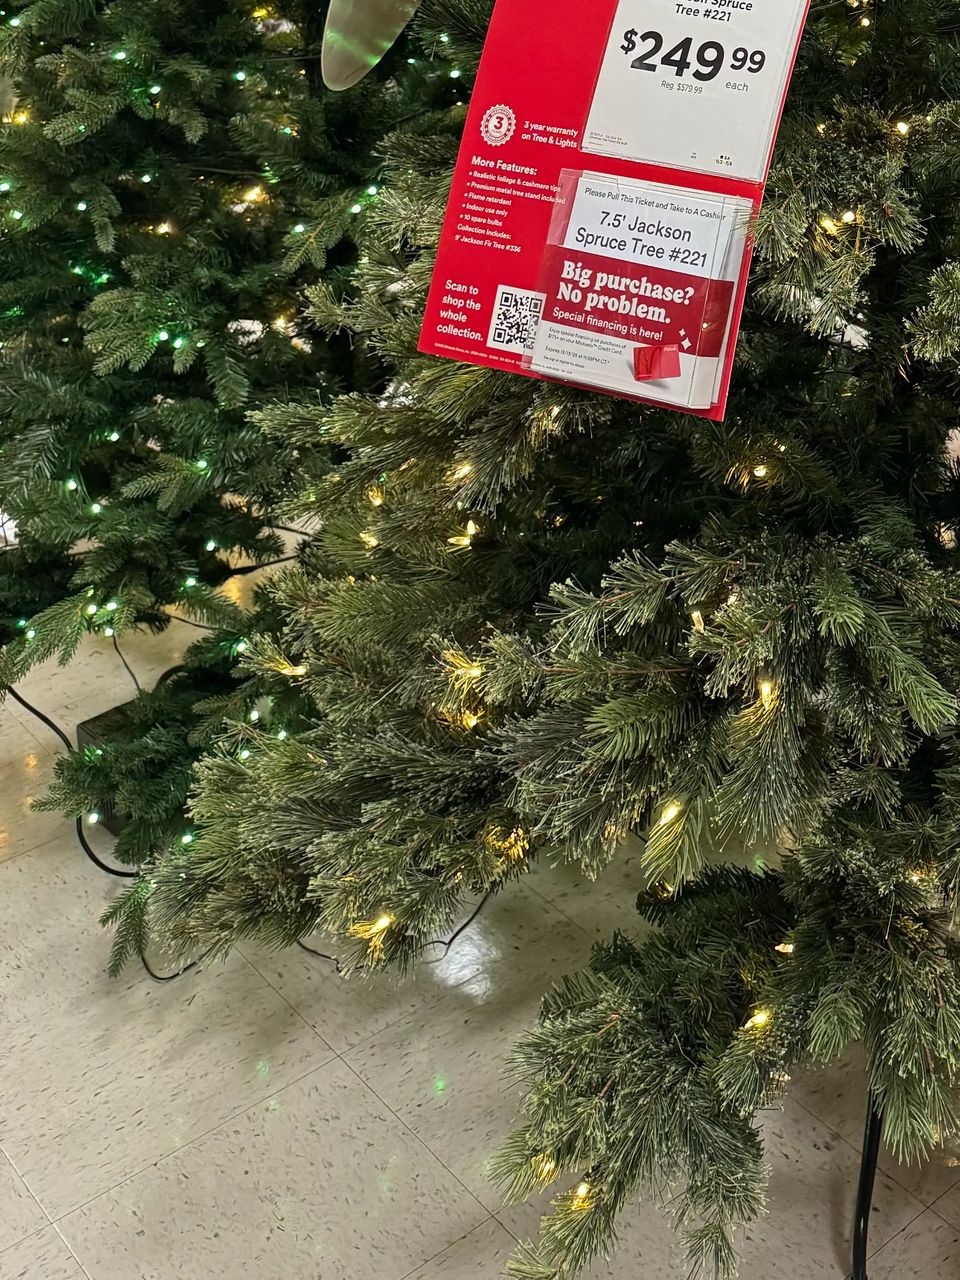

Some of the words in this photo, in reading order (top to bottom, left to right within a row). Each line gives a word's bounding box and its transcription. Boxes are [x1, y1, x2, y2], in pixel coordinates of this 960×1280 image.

[675, 4, 700, 17] Tree
[703, 8, 732, 22] #221
[725, 81, 749, 92] each
[494, 116, 504, 129] 3
[530, 123, 545, 132] year
[546, 126, 578, 137] warranty
[532, 132, 547, 143] Tree
[548, 136, 554, 144] &
[555, 138, 577, 148] Lights
[471, 156, 495, 168] More
[496, 160, 537, 175] Features:
[473, 171, 496, 181] Realistic
[497, 174, 516, 185] foliage
[522, 179, 549, 190] cashmere
[550, 184, 561, 192] tips
[468, 192, 485, 201] Flame
[486, 196, 512, 206] retardant
[470, 181, 495, 192] Premium
[496, 185, 512, 195] metal
[512, 189, 524, 197] tree
[525, 191, 541, 200] stand
[541, 194, 566, 205] included
[584, 187, 606, 200] Please
[606, 190, 620, 201] Pull
[620, 193, 633, 204] This
[635, 197, 655, 208] Ticket
[655, 202, 668, 210] and
[669, 203, 684, 215] Take
[685, 207, 692, 215] to
[693, 208, 699, 216] A
[466, 203, 484, 212] Indoor
[496, 208, 508, 217] only
[471, 216, 487, 225] spare
[487, 217, 502, 226] bulbs
[600, 210, 626, 228] 7.5'
[628, 217, 692, 242] Jackson
[457, 224, 485, 235] Collection
[460, 235, 484, 246] Jackson
[484, 239, 492, 247] Fir
[492, 240, 505, 249] Tree
[575, 227, 627, 251] Spruce
[630, 237, 665, 259] Tree
[669, 247, 708, 268] #221
[445, 280, 468, 294] Scan
[469, 286, 479, 295] to
[561, 260, 593, 288] Big
[594, 271, 695, 306] purchase?
[442, 295, 465, 308] shop
[466, 297, 481, 310] the
[556, 281, 582, 303] No
[584, 291, 671, 324] problem.
[440, 309, 467, 323] whole
[553, 307, 585, 324] Special
[587, 315, 628, 335] financing
[629, 323, 637, 335] is
[639, 325, 664, 341] here!
[436, 324, 483, 341] collection.
